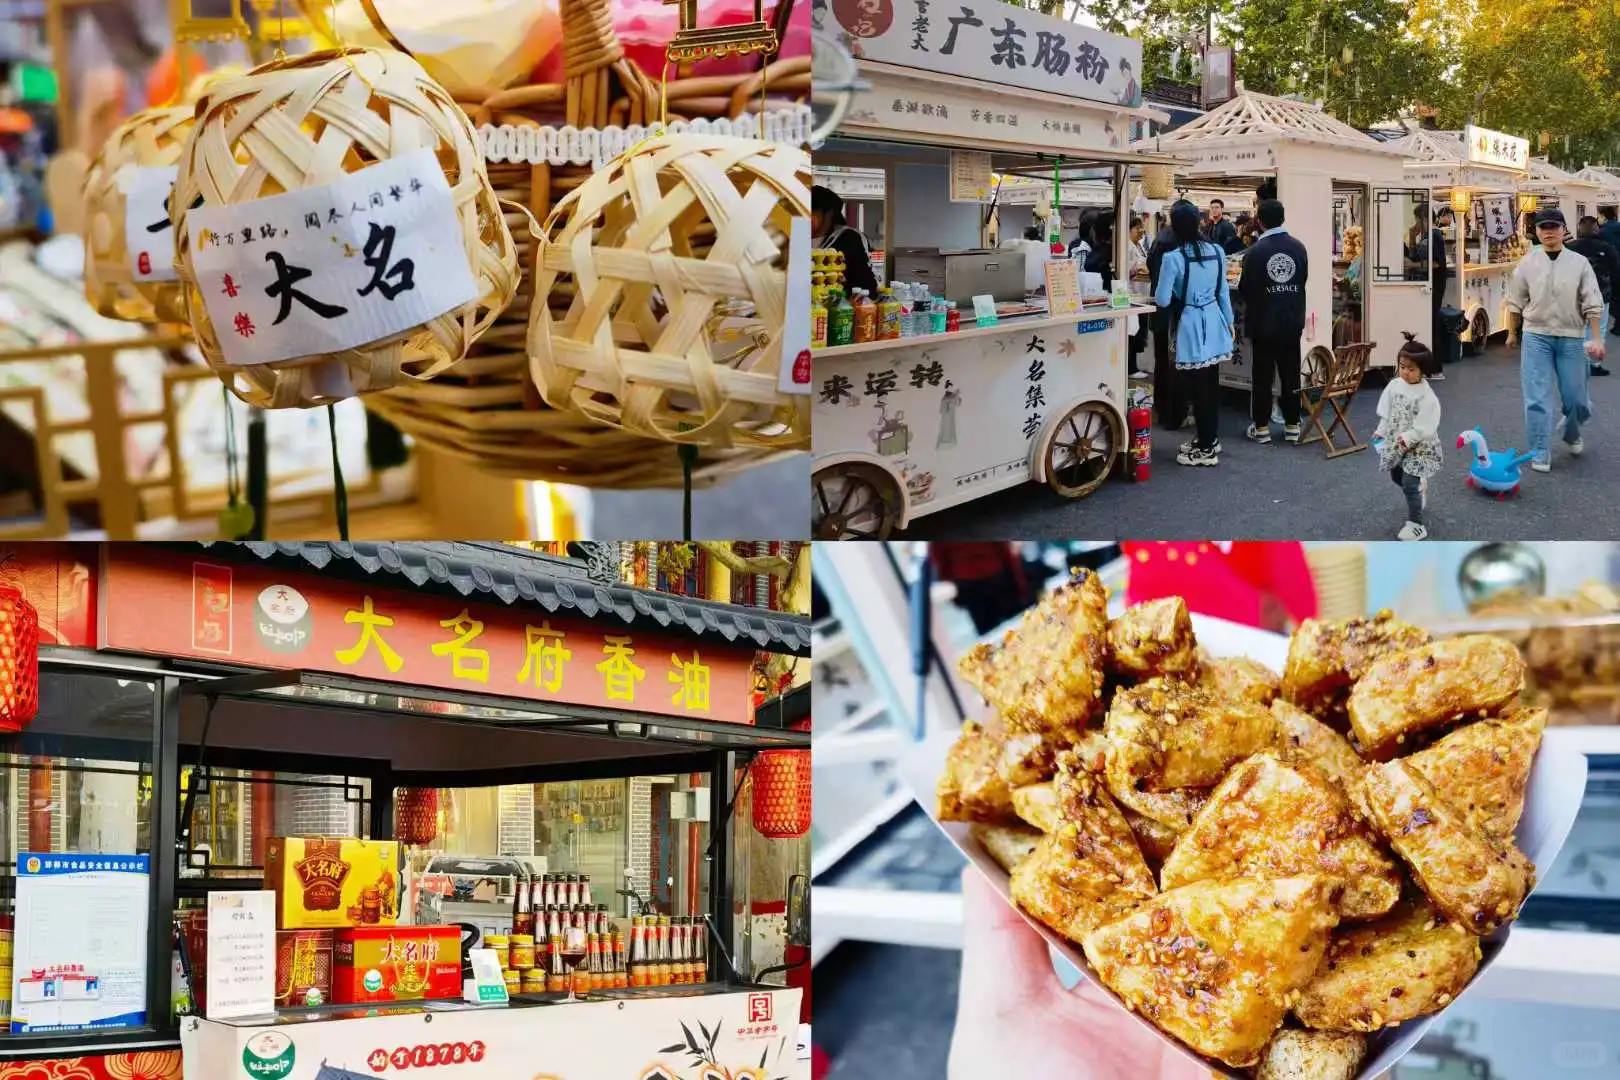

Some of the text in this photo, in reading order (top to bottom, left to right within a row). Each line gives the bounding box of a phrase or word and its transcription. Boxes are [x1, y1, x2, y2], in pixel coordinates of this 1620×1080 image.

[939, 6, 1110, 85] 广东肠粉
[264, 222, 415, 326] 大名
[1265, 284, 1299, 294] VERSACE
[334, 595, 711, 713] 大名府香油
[304, 860, 343, 881] 大名府
